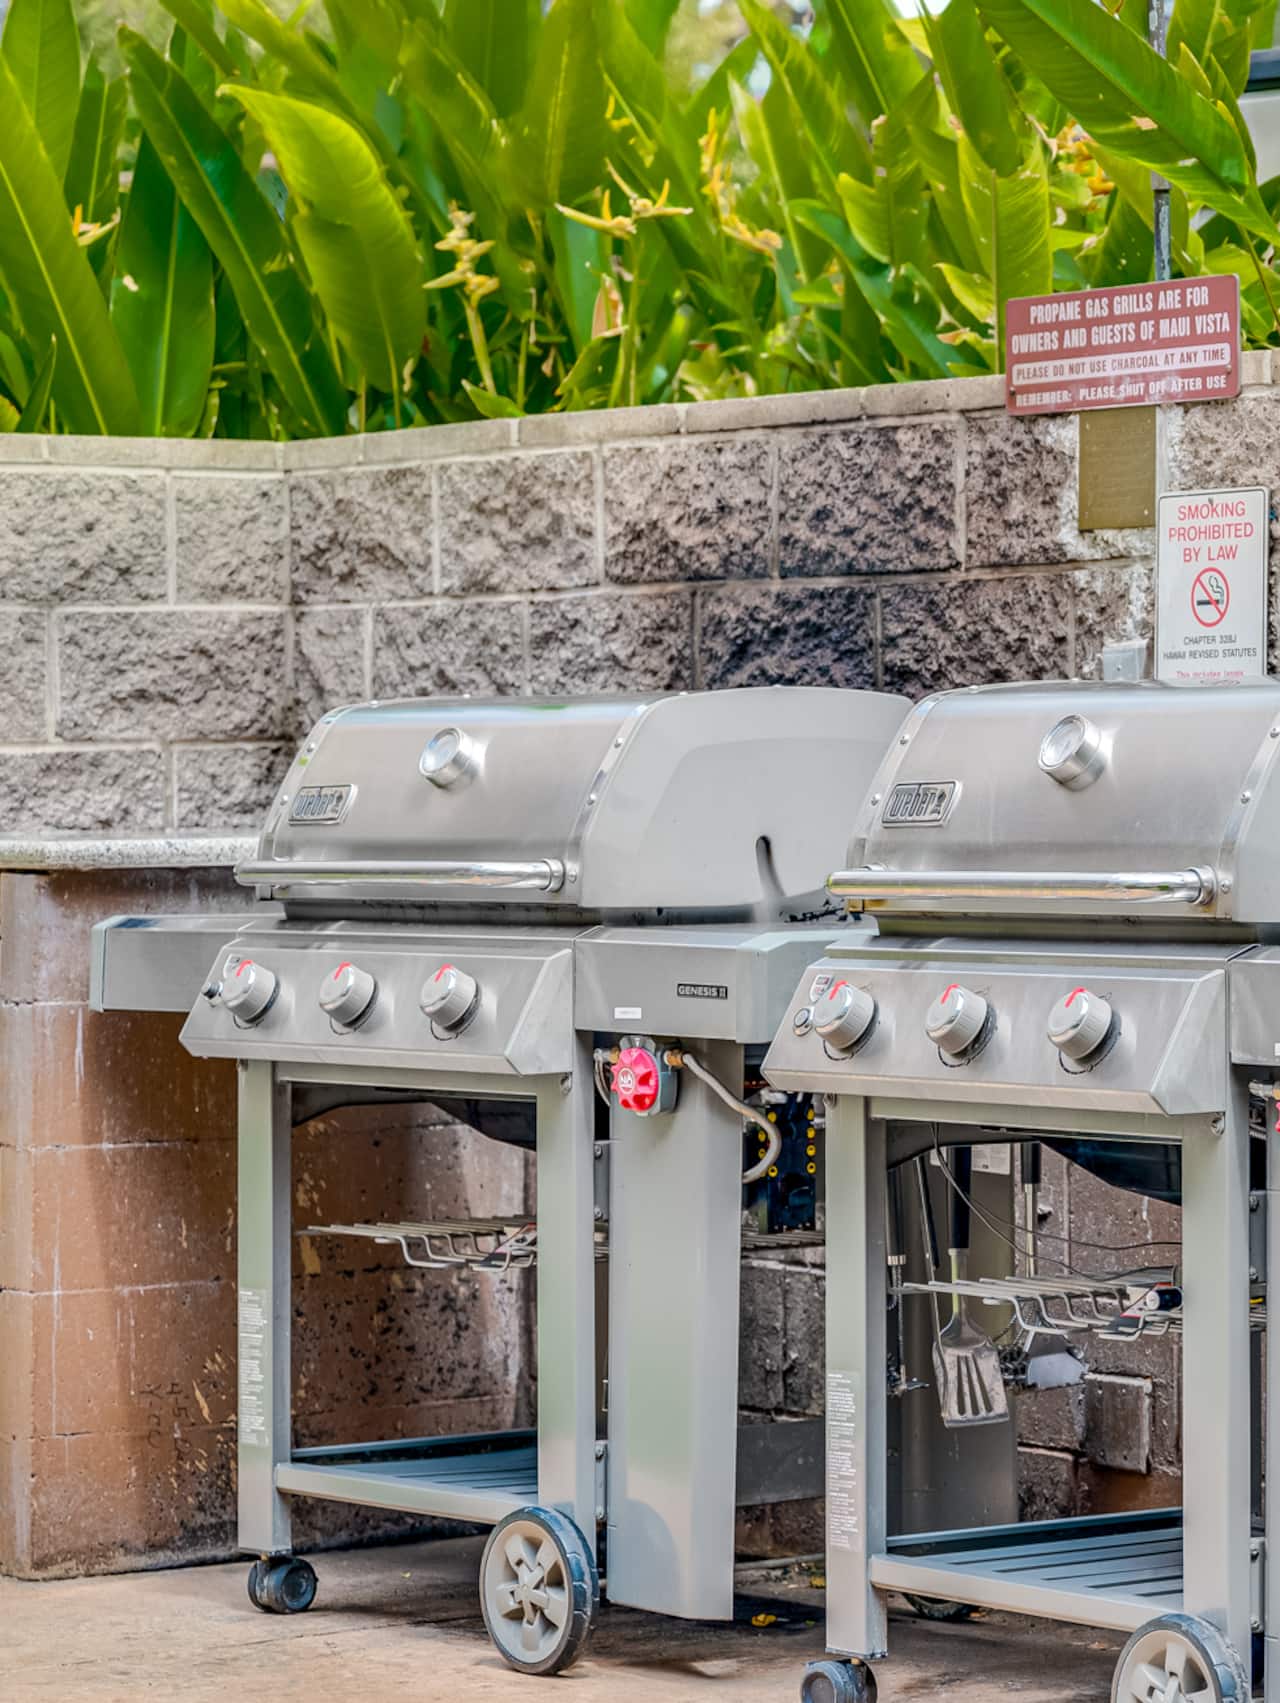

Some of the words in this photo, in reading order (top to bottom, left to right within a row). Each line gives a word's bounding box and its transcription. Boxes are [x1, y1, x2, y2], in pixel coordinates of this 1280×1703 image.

[1030, 300, 1081, 325] PROPANE
[1086, 297, 1109, 318] GAS
[1113, 292, 1153, 316] GRILLS
[1158, 289, 1182, 311] ARE
[1186, 286, 1209, 308] FOR
[1011, 330, 1059, 354] OWNERS
[1063, 328, 1087, 349] AND
[1091, 322, 1136, 346] GUESTS
[1140, 320, 1155, 341] OF
[1159, 316, 1191, 339] MAUI
[1195, 312, 1230, 336] VISTA
[1016, 366, 1049, 380] PLEASE
[1053, 364, 1065, 377] DO
[1069, 363, 1085, 375] NOT
[1090, 360, 1106, 373] USE
[1111, 354, 1160, 371] CHARCOAL
[1164, 353, 1175, 365] AT
[1180, 350, 1198, 364] ANY
[1203, 348, 1225, 361] TIME
[1015, 390, 1072, 408] REMEMBER:
[1080, 385, 1115, 401] PLEASE
[1120, 382, 1146, 397] SHUT
[1149, 380, 1168, 394] OFF
[1171, 377, 1203, 393] AFTER
[1206, 375, 1227, 390] USE
[1177, 501, 1246, 521] SMOKING
[1168, 522, 1254, 542] PROHIBITED
[1183, 546, 1201, 563] BY
[1207, 544, 1238, 561] LAW
[1183, 635, 1217, 646] CHAPTER
[1189, 648, 1219, 659] REVISED
[1222, 647, 1257, 658] STATUTES
[679, 985, 718, 997] GENESIS
